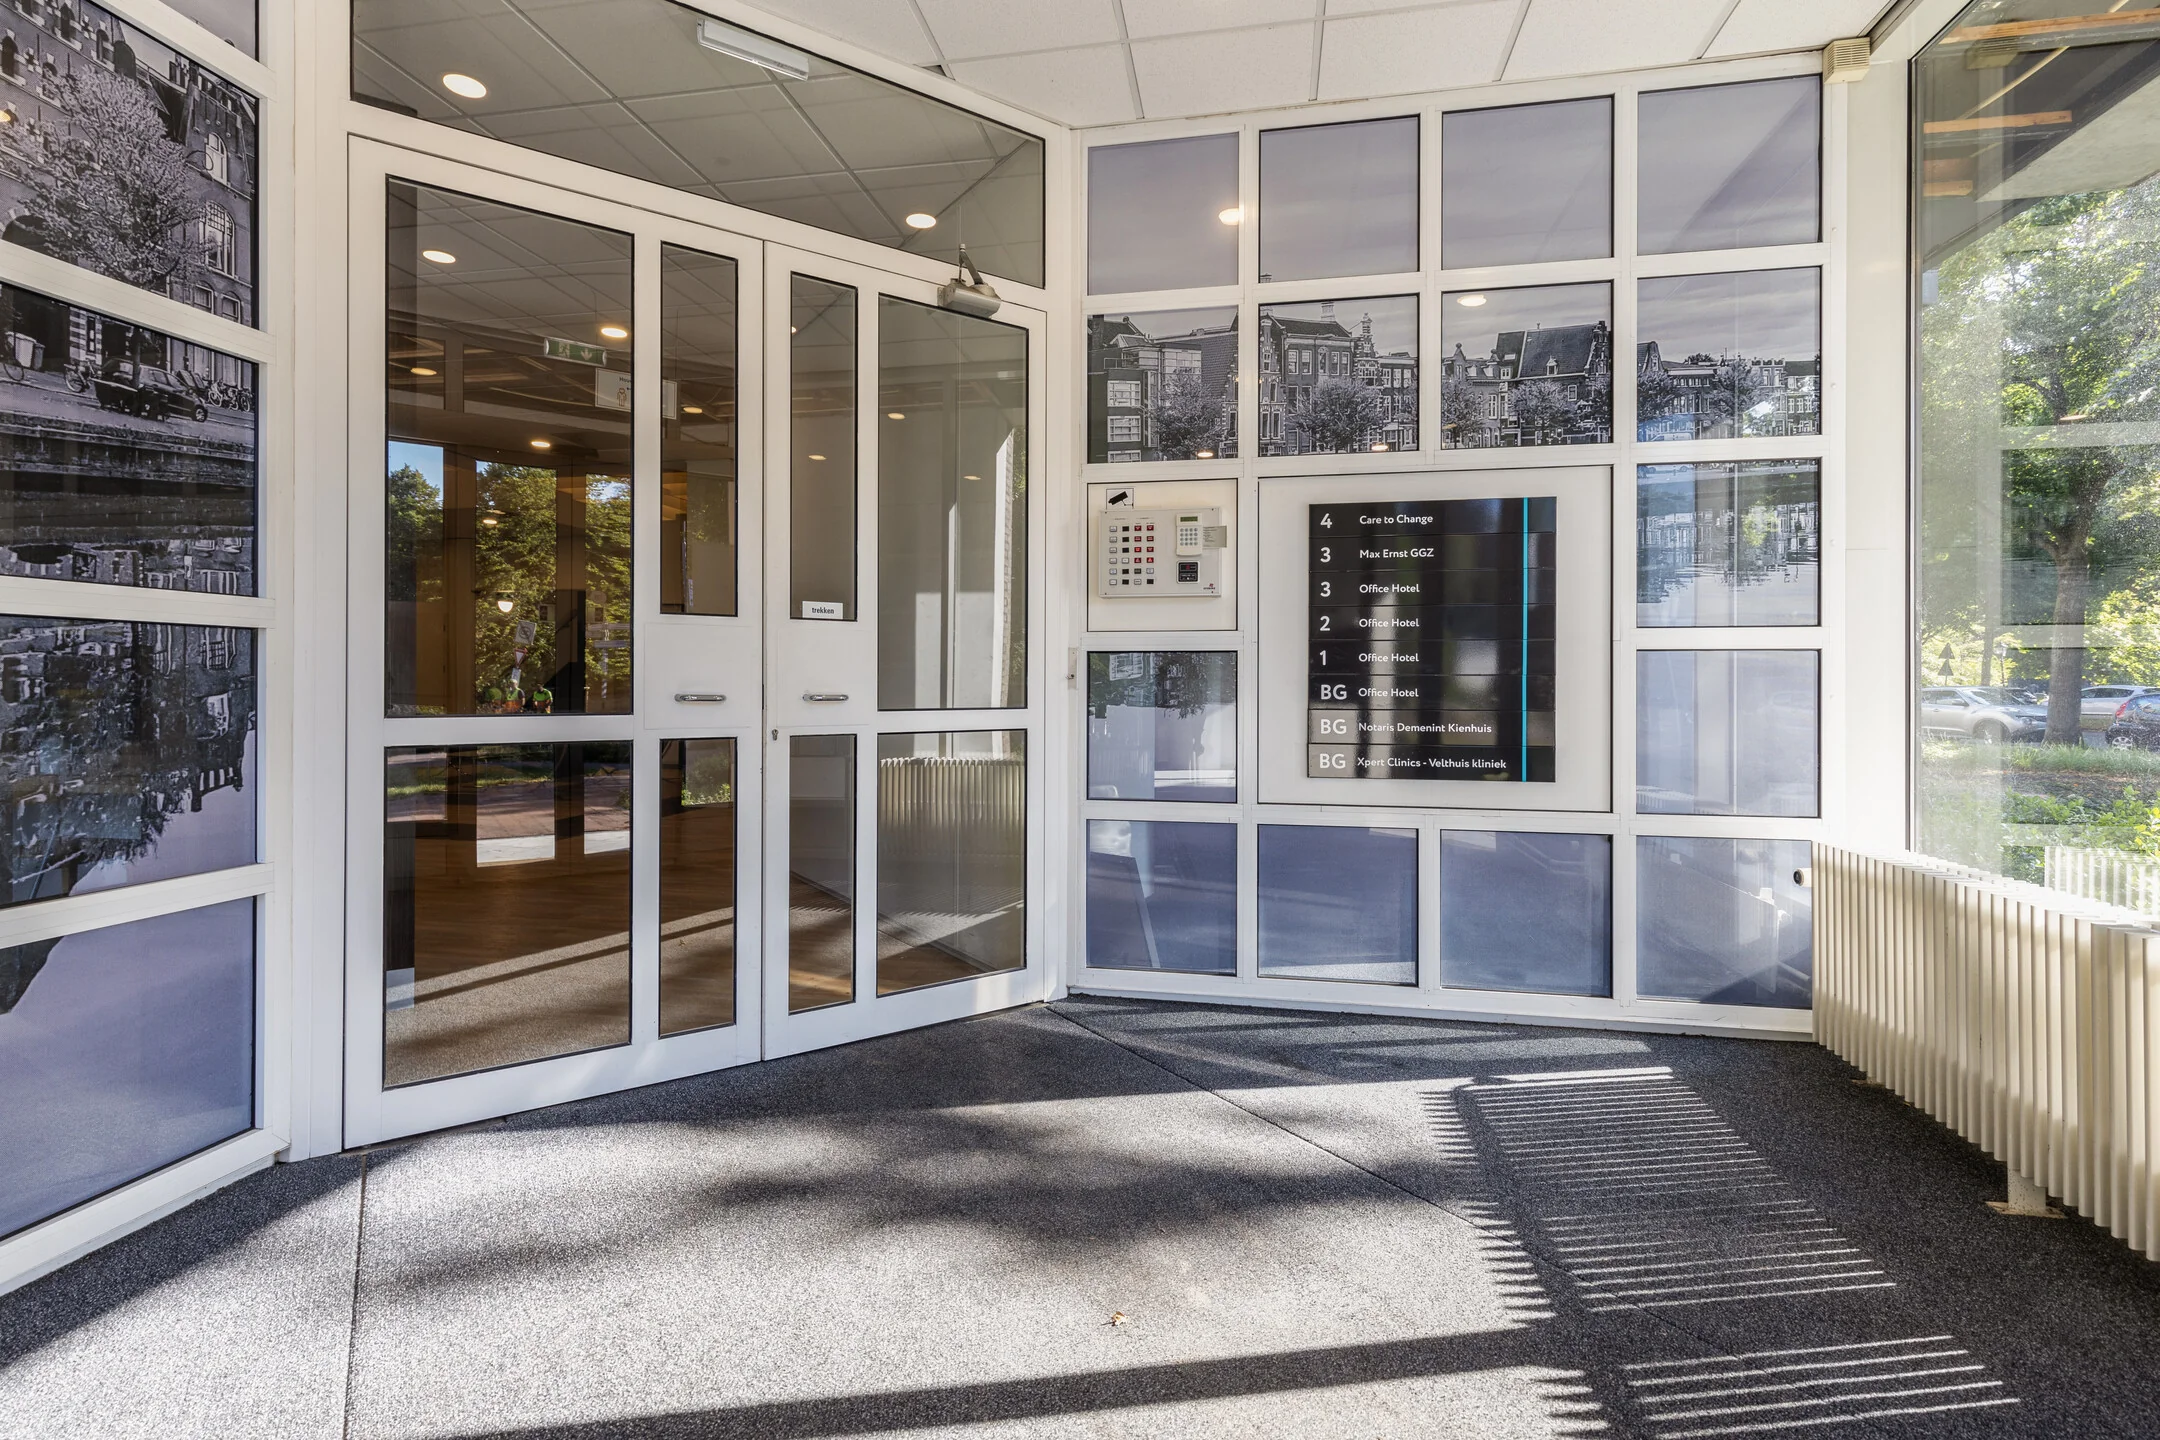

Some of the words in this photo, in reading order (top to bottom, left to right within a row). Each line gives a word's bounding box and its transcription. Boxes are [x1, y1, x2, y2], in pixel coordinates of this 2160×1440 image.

[1320, 513, 1332, 528] 4
[1359, 516, 1382, 524] Care
[1384, 516, 1394, 524] to
[1396, 514, 1433, 525] Change
[1320, 547, 1331, 562] 3
[1360, 550, 1380, 558] Max
[1383, 549, 1408, 558] Ernst
[1410, 548, 1434, 557] GGZ
[1320, 581, 1331, 597] 3
[1359, 584, 1389, 593] Office
[1392, 584, 1420, 592] Hotel
[1320, 616, 1330, 632] 2
[1359, 618, 1389, 628] Office
[1392, 618, 1420, 627] Hotel
[1320, 650, 1327, 666] 1
[1358, 653, 1388, 662] Office
[1391, 653, 1419, 662] Hotel
[1320, 684, 1347, 700] BG
[1358, 688, 1388, 697] Office
[1391, 688, 1419, 697] Hotel
[1320, 719, 1347, 735] BG
[1358, 722, 1394, 732] Notaris
[1397, 723, 1445, 732] Demenint
[1448, 723, 1492, 733] Kienhuis
[1319, 753, 1346, 769] BG
[1357, 757, 1385, 768] Xpert
[1387, 758, 1420, 767] Clinics
[1429, 758, 1470, 768] Velthuis
[1472, 759, 1506, 769] kliniek
